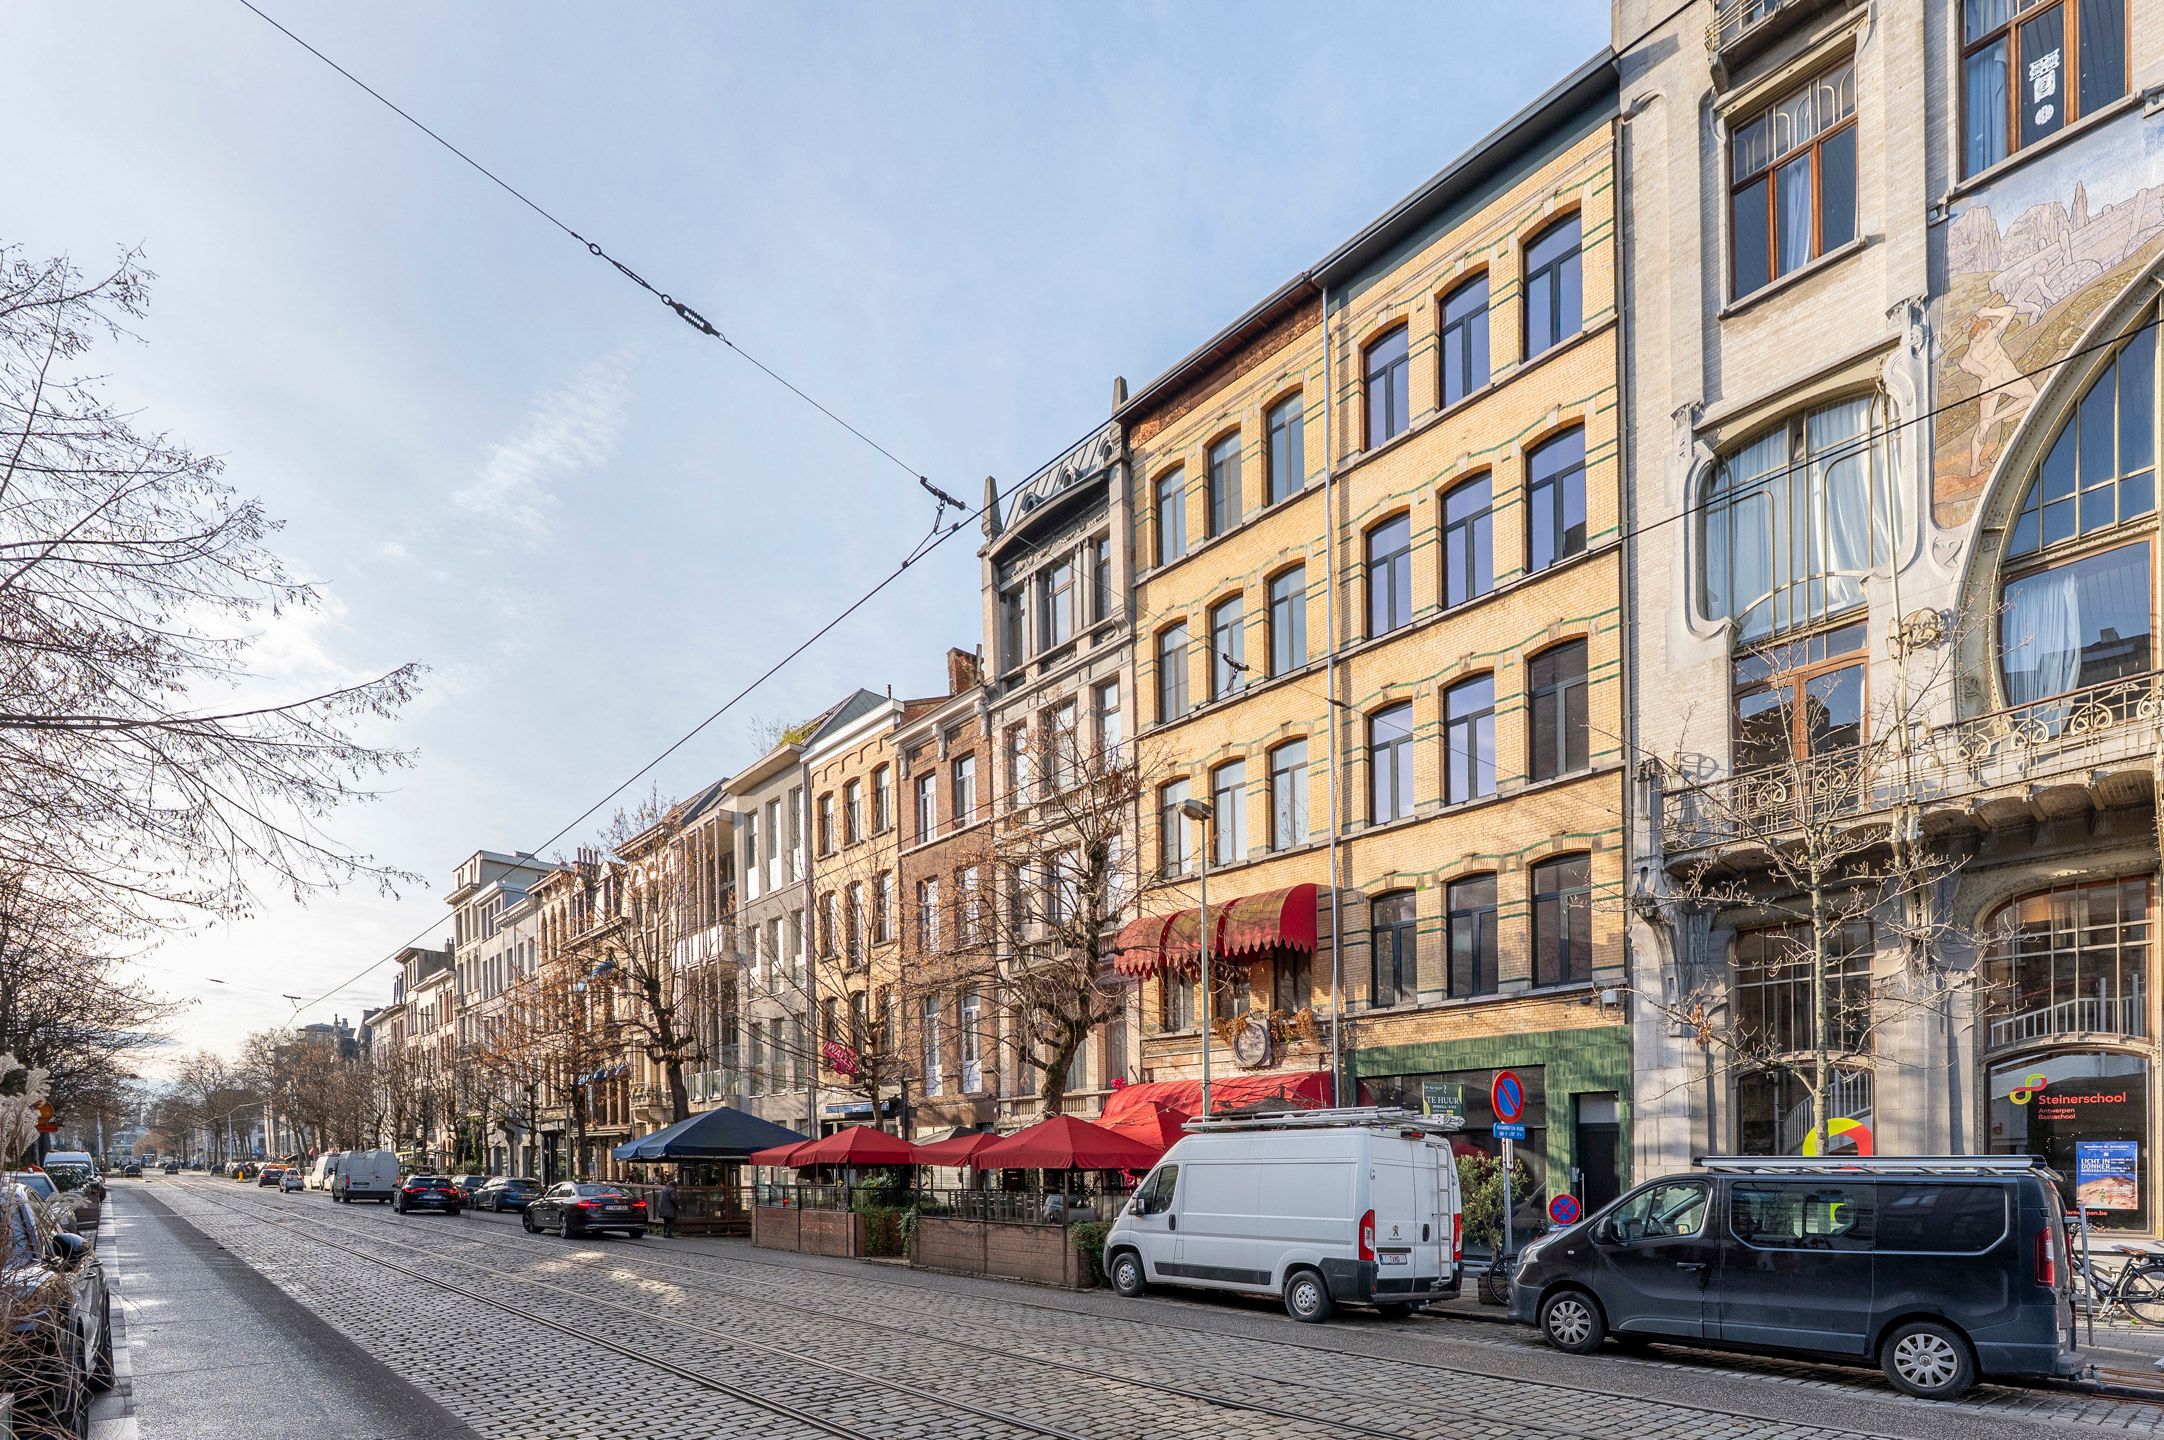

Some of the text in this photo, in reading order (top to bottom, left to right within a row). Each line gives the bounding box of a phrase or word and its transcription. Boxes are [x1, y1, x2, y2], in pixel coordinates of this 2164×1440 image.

[827, 1041, 853, 1070] WALLS
[1426, 1096, 1459, 1105] TE HUUR
[2038, 1092, 2126, 1105] Steinerschool
